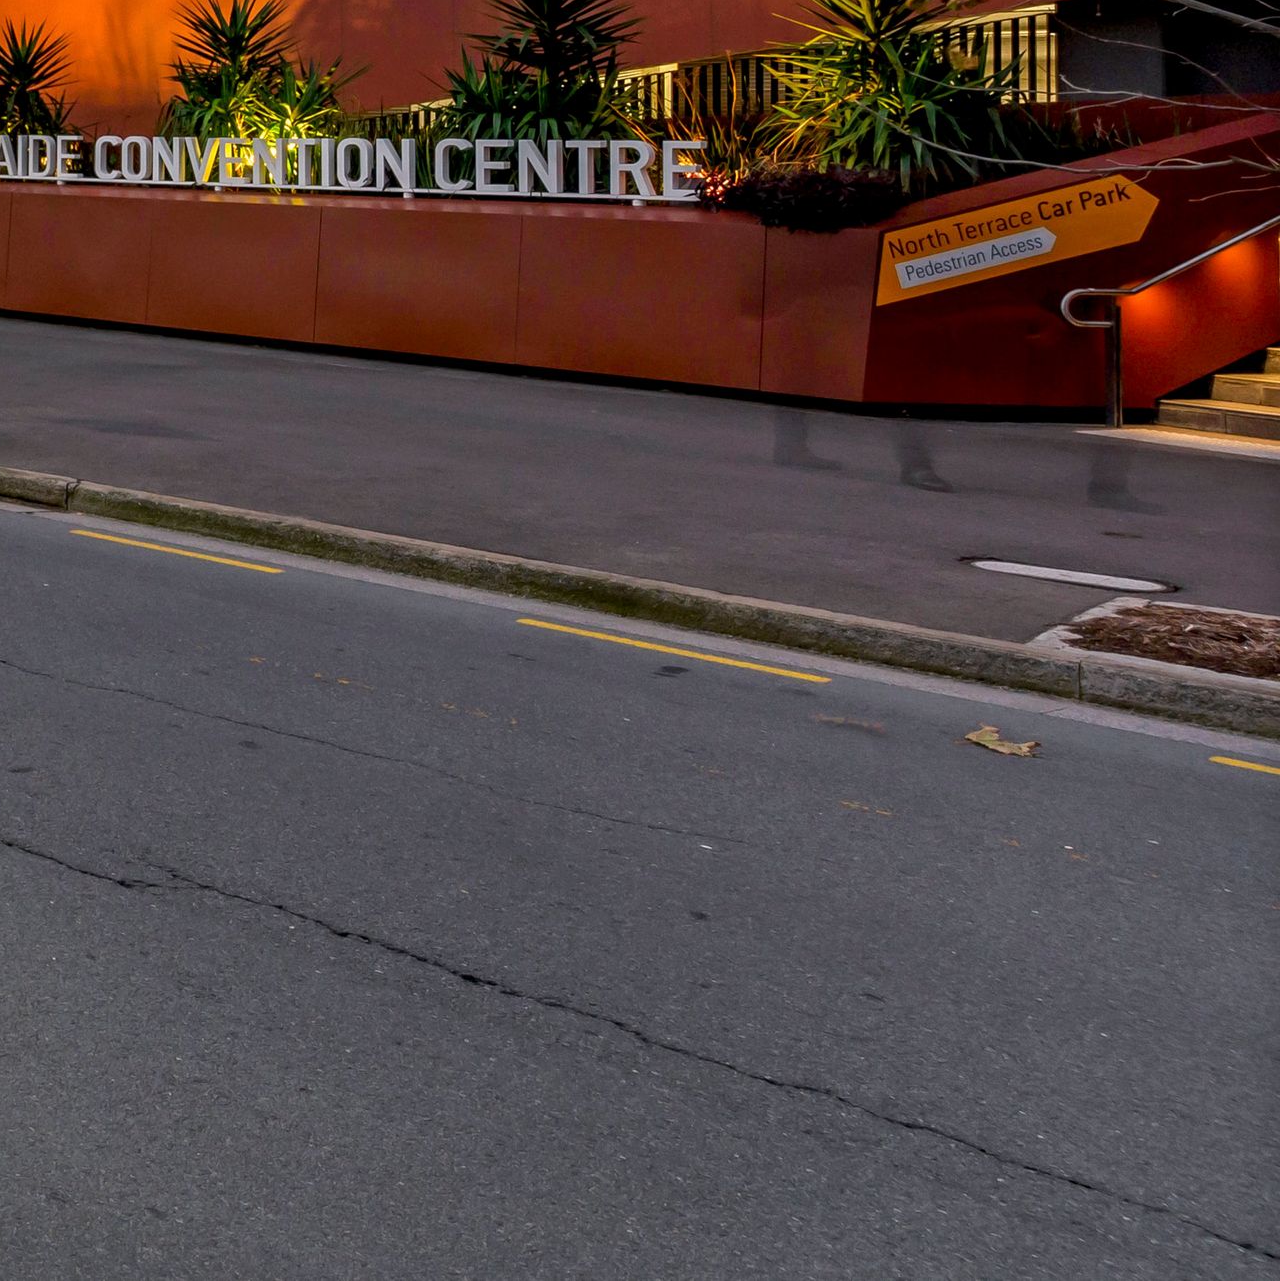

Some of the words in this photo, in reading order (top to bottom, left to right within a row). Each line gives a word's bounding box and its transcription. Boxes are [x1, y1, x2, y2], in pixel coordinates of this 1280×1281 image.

[94, 135, 416, 191] CONVENTION
[434, 138, 708, 198] CENTRE
[888, 229, 950, 259] North
[953, 210, 1032, 242] Terrace
[1038, 199, 1073, 221] Car
[1079, 182, 1131, 211] Park
[905, 251, 986, 281] Pedestrian
[990, 235, 1043, 261] Access
